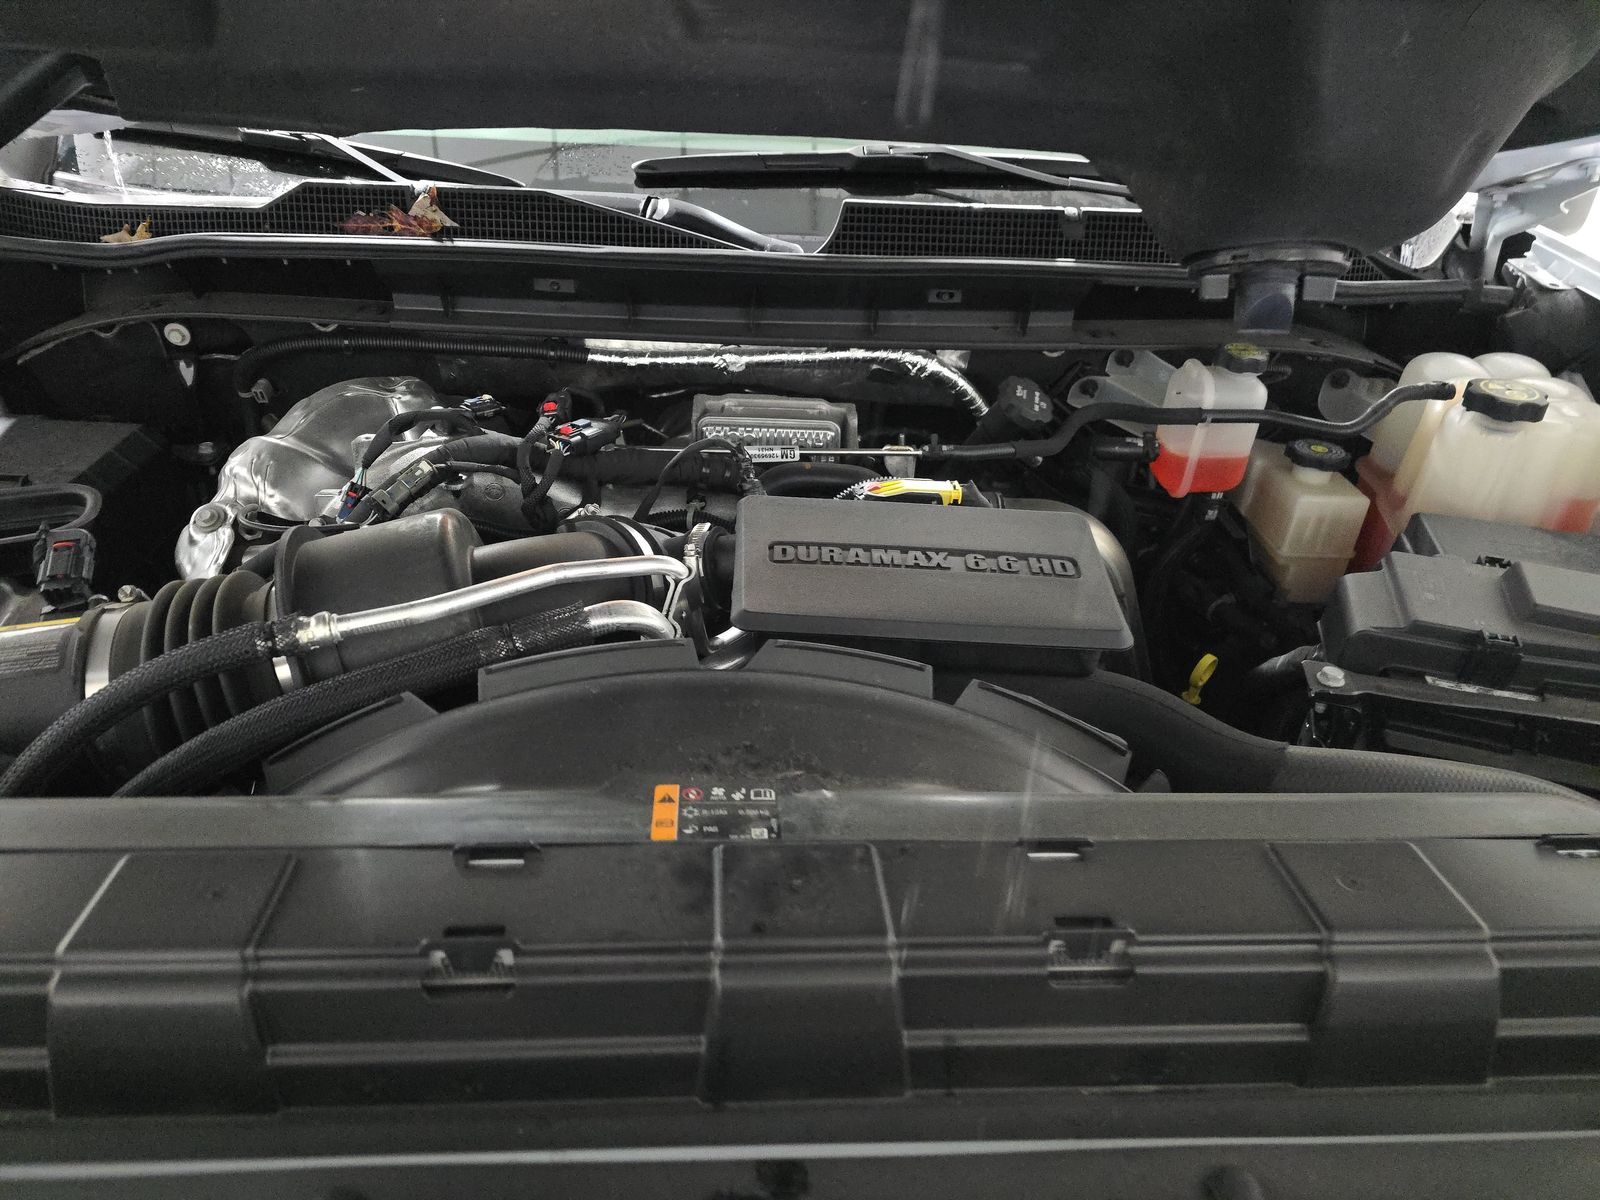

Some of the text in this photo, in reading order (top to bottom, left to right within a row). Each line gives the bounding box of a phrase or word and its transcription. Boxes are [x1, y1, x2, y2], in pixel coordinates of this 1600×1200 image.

[780, 449, 796, 460] GM
[773, 545, 1077, 577] DURAMAX 6.6 HD
